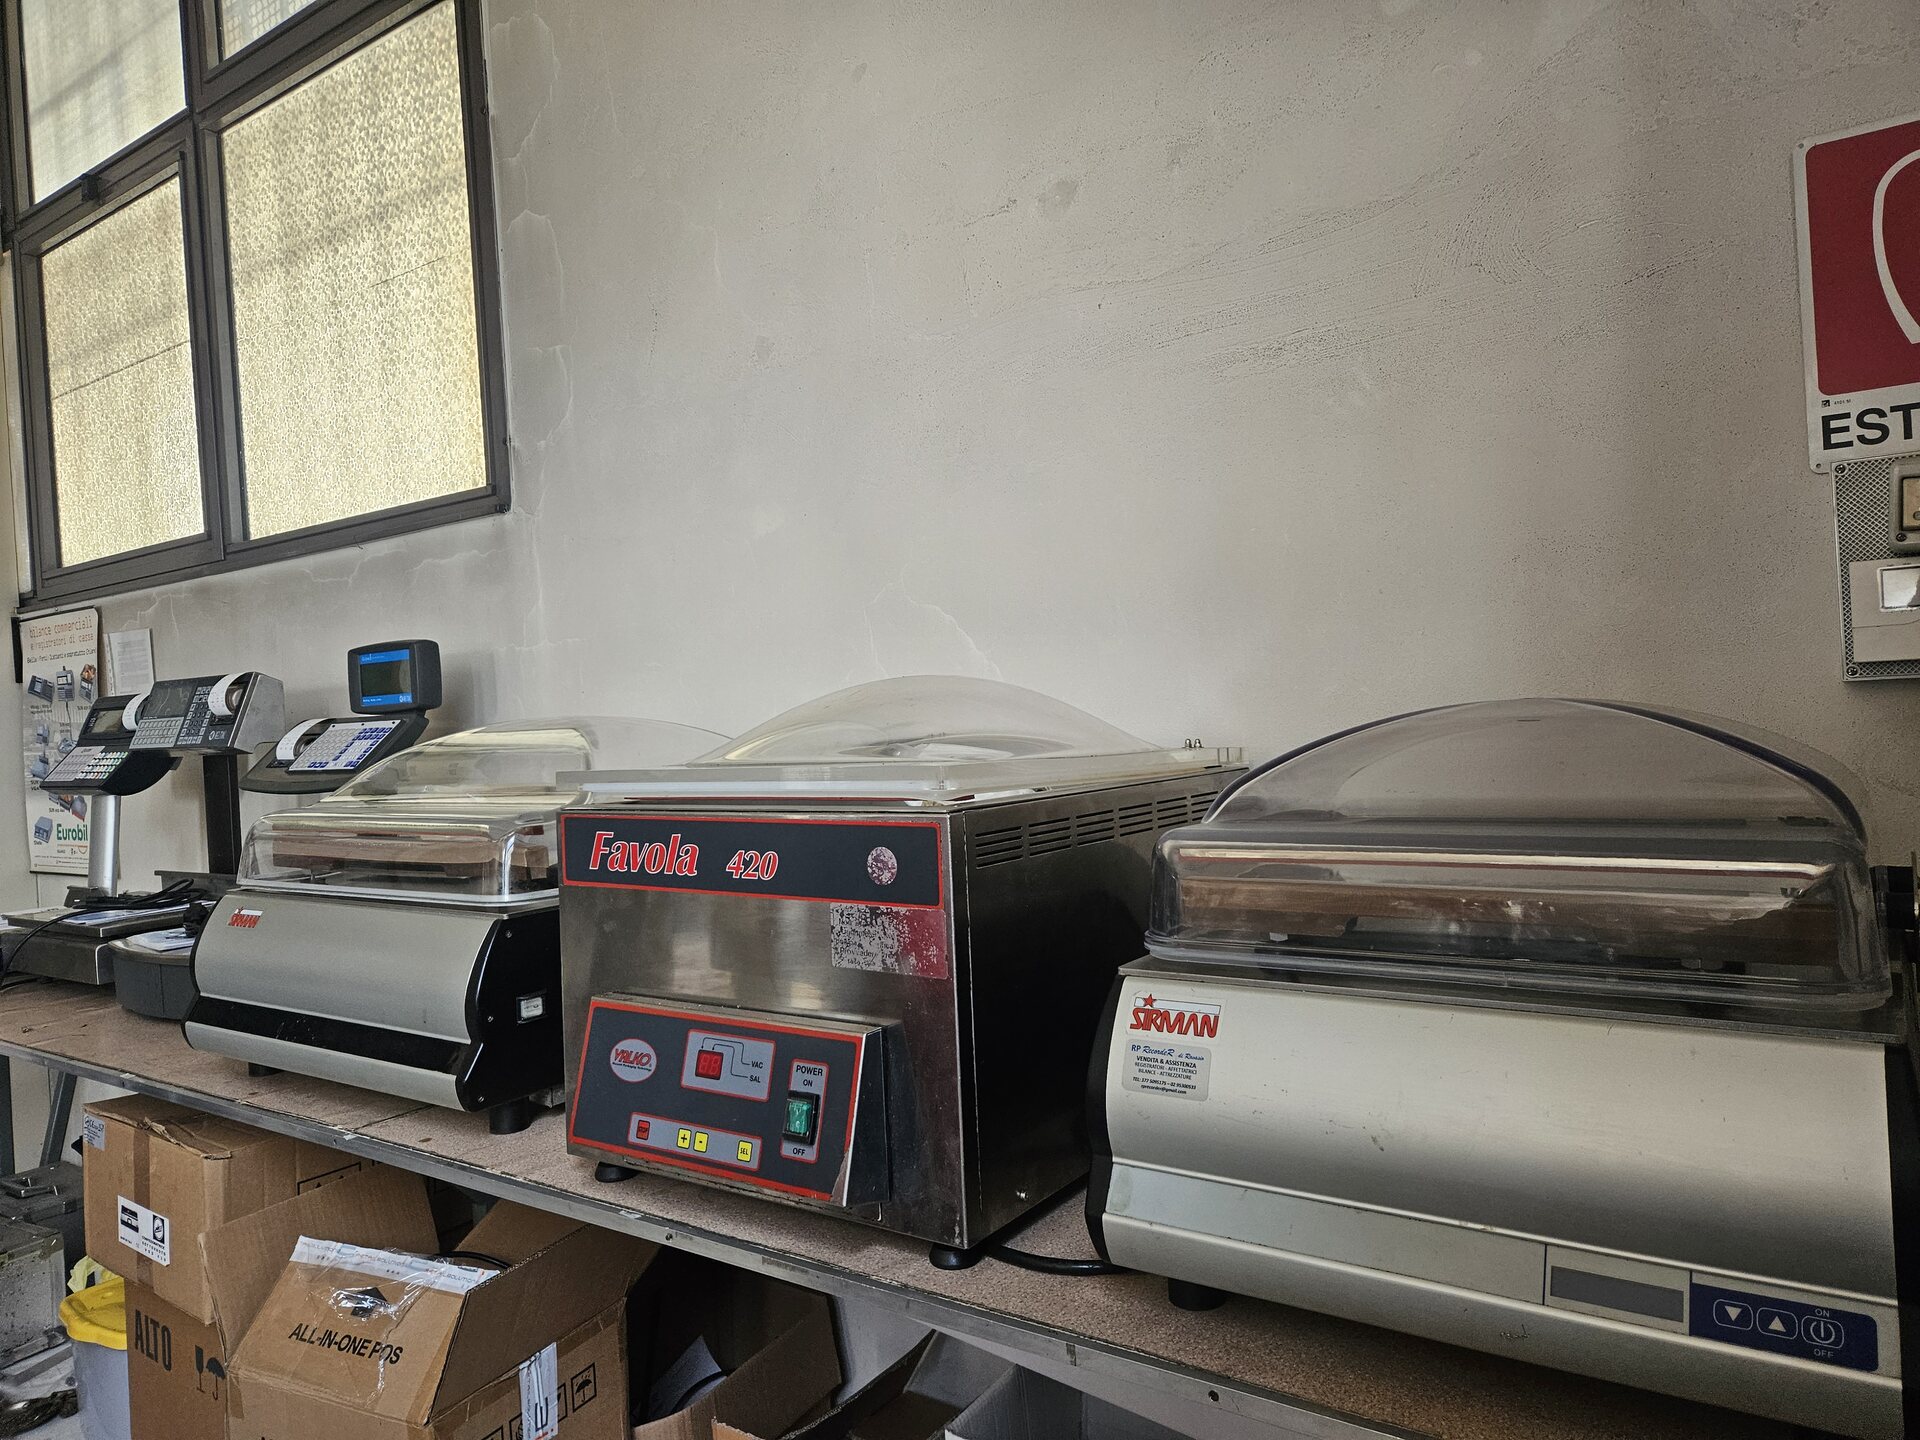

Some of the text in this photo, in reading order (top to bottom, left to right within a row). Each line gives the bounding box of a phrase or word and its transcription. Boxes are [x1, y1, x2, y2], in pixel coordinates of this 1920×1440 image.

[1822, 402, 1920, 450] EST
[54, 615, 93, 634] commerciali
[56, 823, 89, 842] Eurobil
[589, 831, 779, 881] Favola 420
[1129, 1007, 1220, 1039] SIRMAN
[1131, 1044, 1141, 1052] RP
[614, 1048, 652, 1067] VALKO
[1136, 1055, 1158, 1064] VENDITA
[1165, 1060, 1197, 1069] ASSISTENZA
[751, 1061, 764, 1069] VAC
[796, 1065, 823, 1076] POWER
[1135, 1062, 1165, 1070] REGISTRATORI
[749, 1074, 761, 1083] SAL
[1159, 1071, 1192, 1080] ATTREZZATURE
[802, 1079, 813, 1087] ON
[740, 1147, 749, 1156] SEL
[792, 1147, 806, 1156] OFF
[1815, 1308, 1830, 1318] ON
[134, 1309, 172, 1371] ALTO
[288, 1322, 404, 1365] ALL-IN-ONE POS
[1813, 1348, 1834, 1359] OFF
